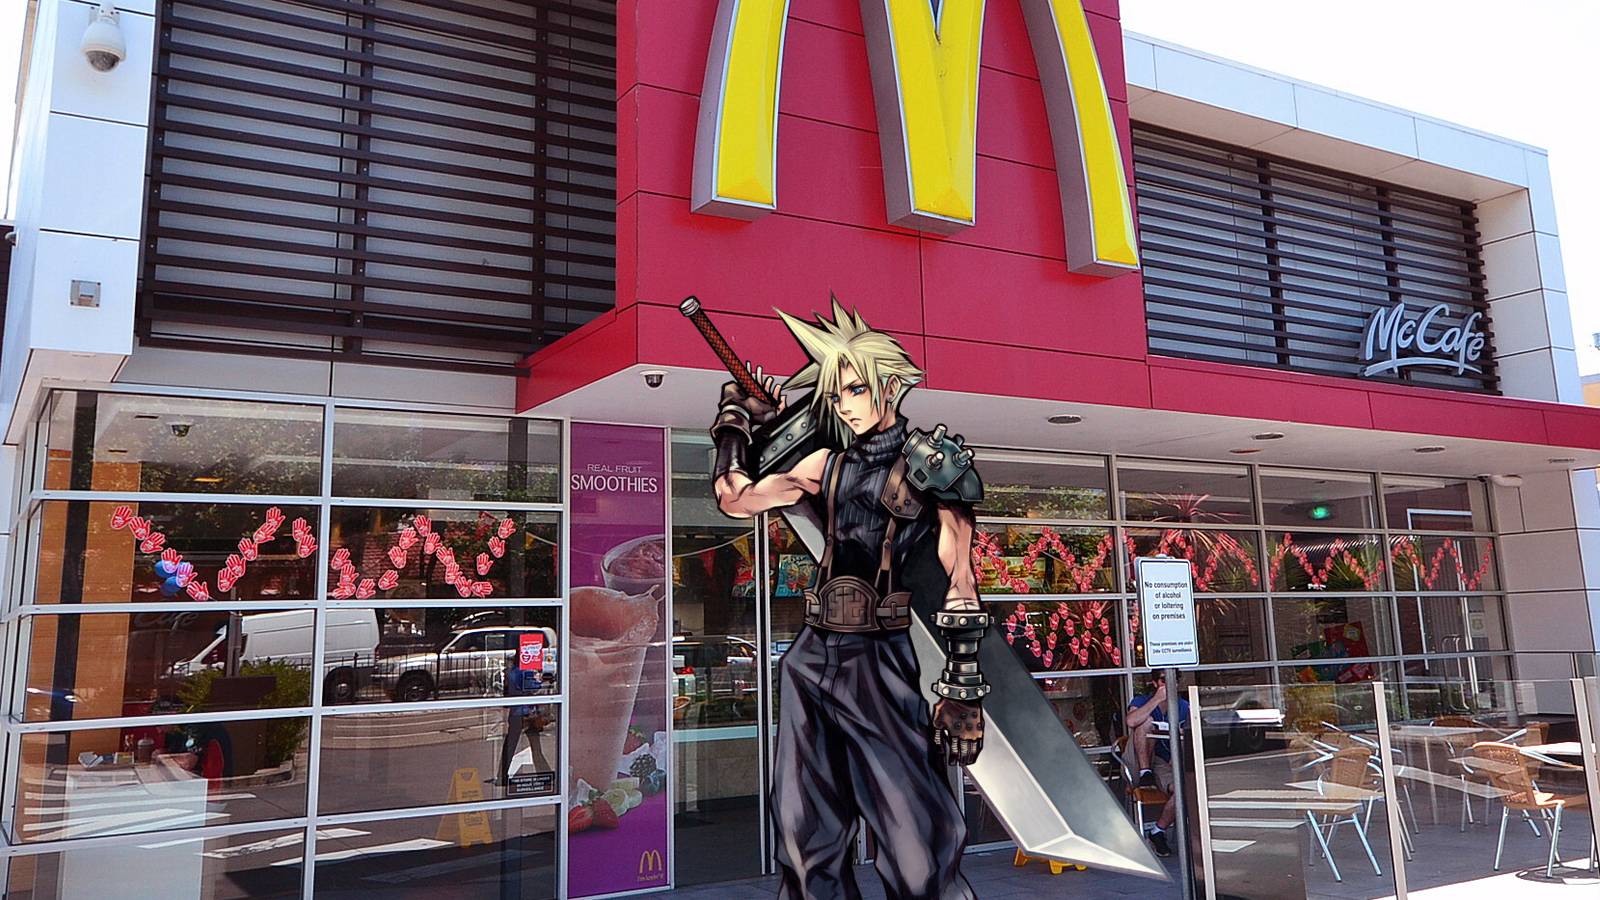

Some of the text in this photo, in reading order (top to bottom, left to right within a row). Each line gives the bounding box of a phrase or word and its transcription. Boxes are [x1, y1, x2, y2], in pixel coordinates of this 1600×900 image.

[587, 463, 642, 474] REAL FRUIT
[571, 474, 658, 493] SMOOTHIES
[1145, 581, 1187, 589] No consumption
[1162, 591, 1181, 599] alcohol
[1162, 602, 1184, 610] loitering
[1161, 612, 1185, 620] premises
